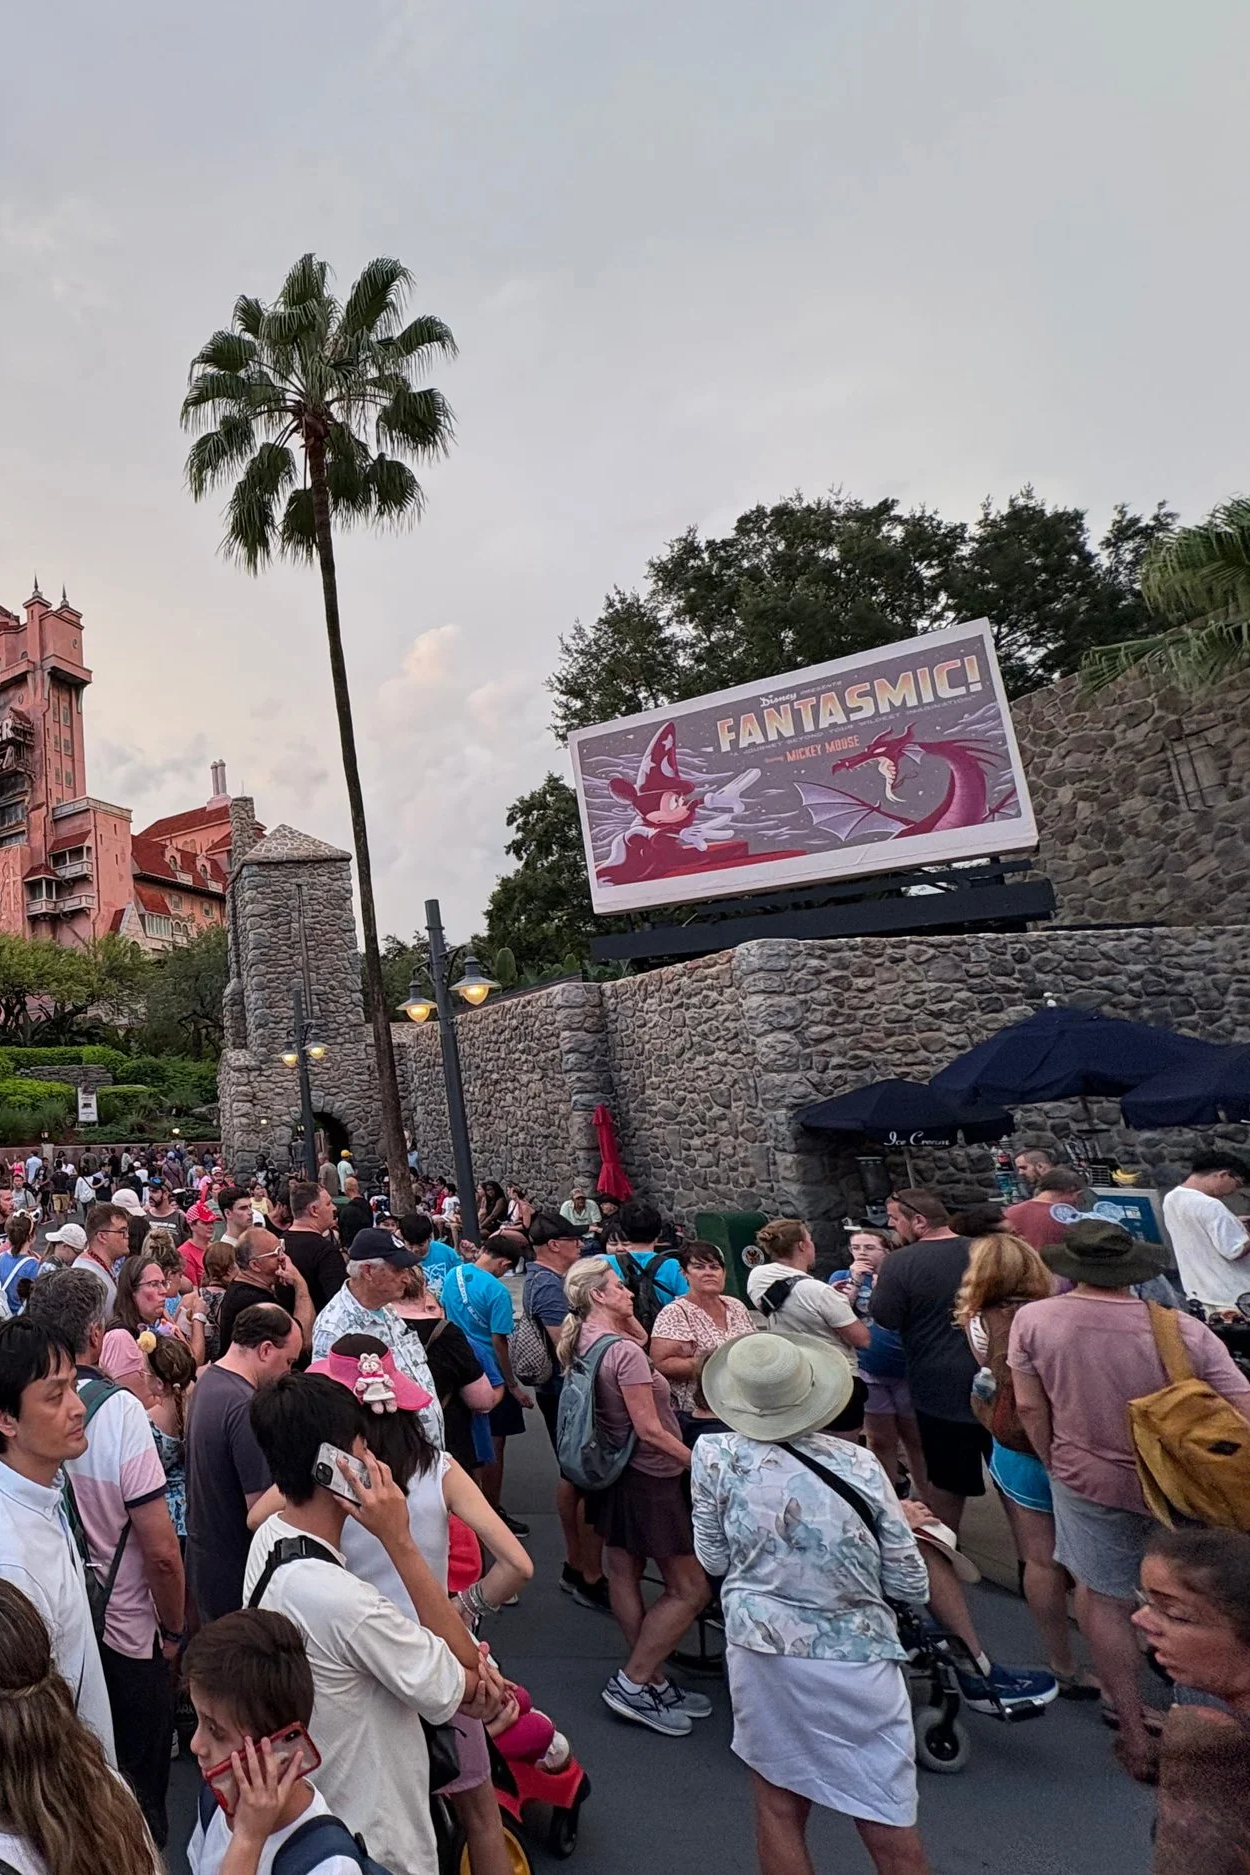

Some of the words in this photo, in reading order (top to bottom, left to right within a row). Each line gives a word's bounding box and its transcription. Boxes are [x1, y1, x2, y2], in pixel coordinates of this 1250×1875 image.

[716, 655, 982, 753] FANTASMIC!
[759, 692, 797, 708] Disney
[785, 743, 822, 763] MICKEY
[824, 735, 861, 754] MOUSE
[883, 1130, 907, 1146] Ice
[909, 1130, 951, 1146] Cream
